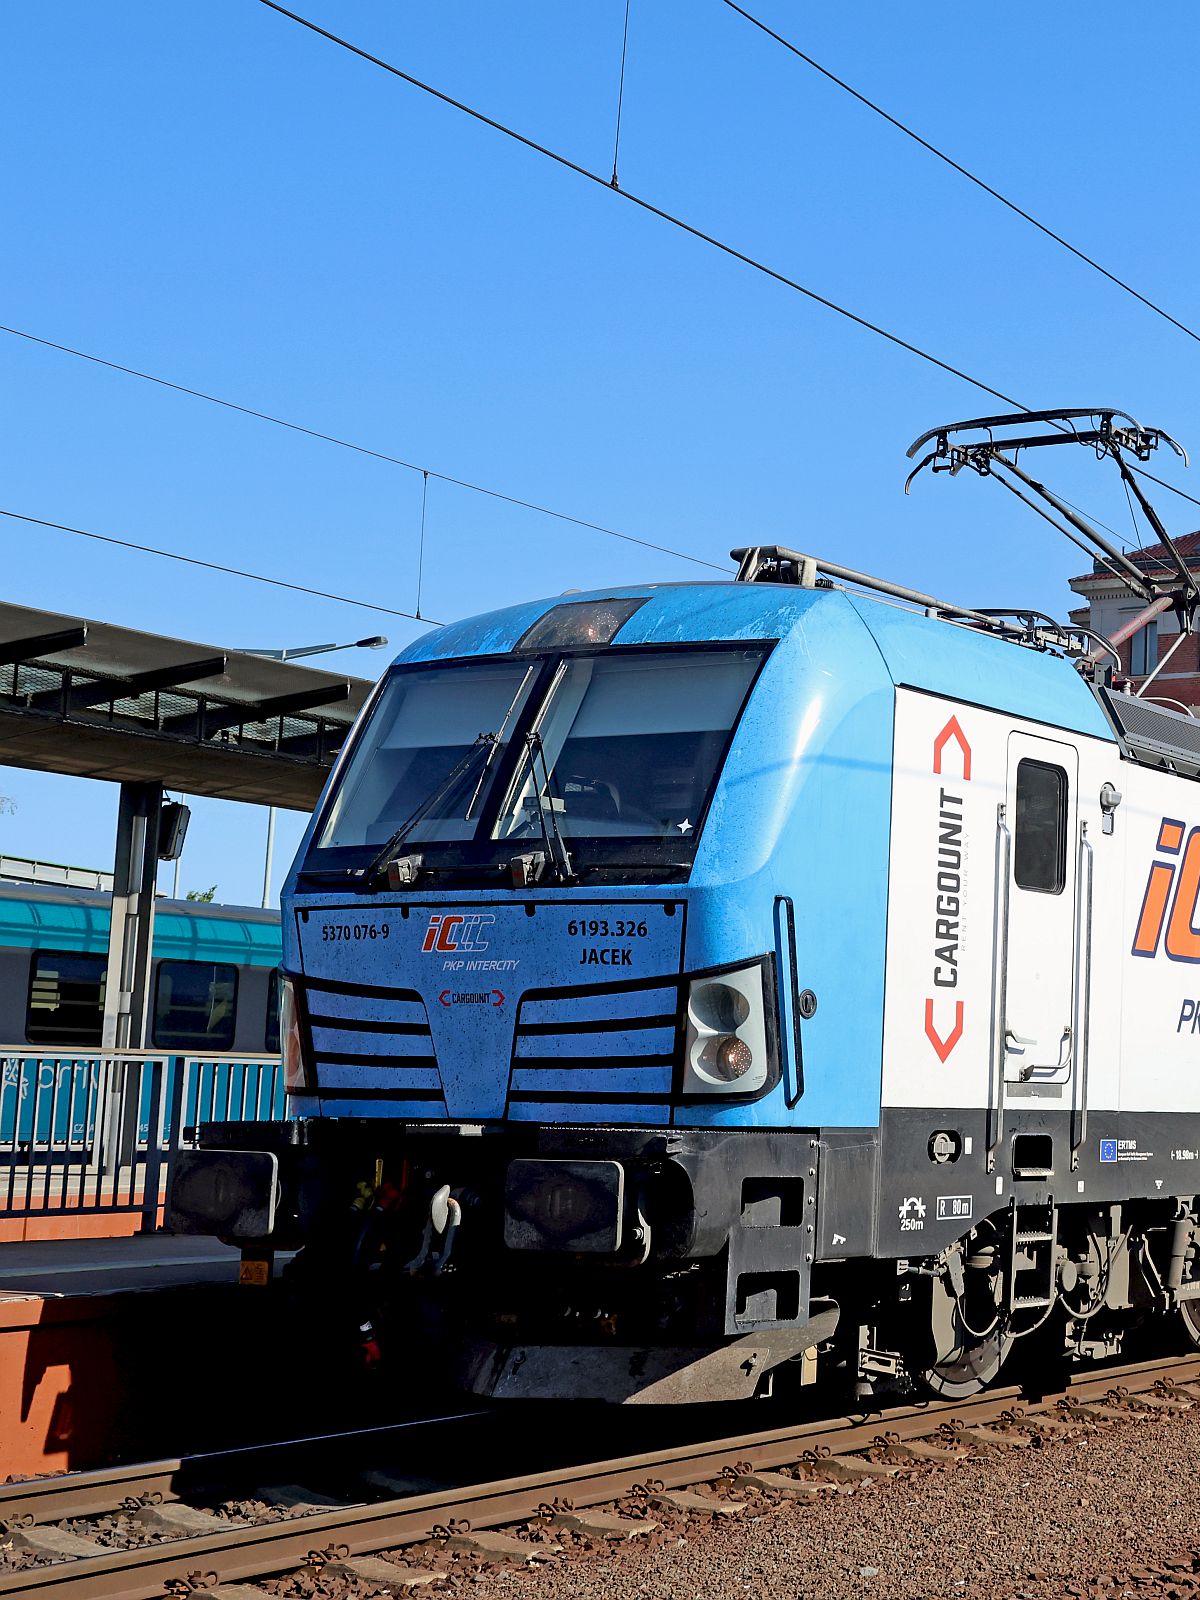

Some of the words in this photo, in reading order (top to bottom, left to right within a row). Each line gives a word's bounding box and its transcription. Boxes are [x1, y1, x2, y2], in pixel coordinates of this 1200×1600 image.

[933, 787, 963, 988] CARGOUNIT
[322, 925, 351, 941] 5370
[353, 923, 390, 940] 076-9
[567, 920, 648, 937] 6193.326
[579, 949, 633, 965] JACEK
[442, 960, 464, 971] PKP
[466, 960, 520, 971] INTERCITY
[452, 992, 491, 1004] CARGOUNIT
[1118, 1139, 1137, 1150] ERTMS
[940, 1199, 946, 1216] R
[952, 1199, 969, 1215] 80m
[900, 1218, 924, 1231] 250m
